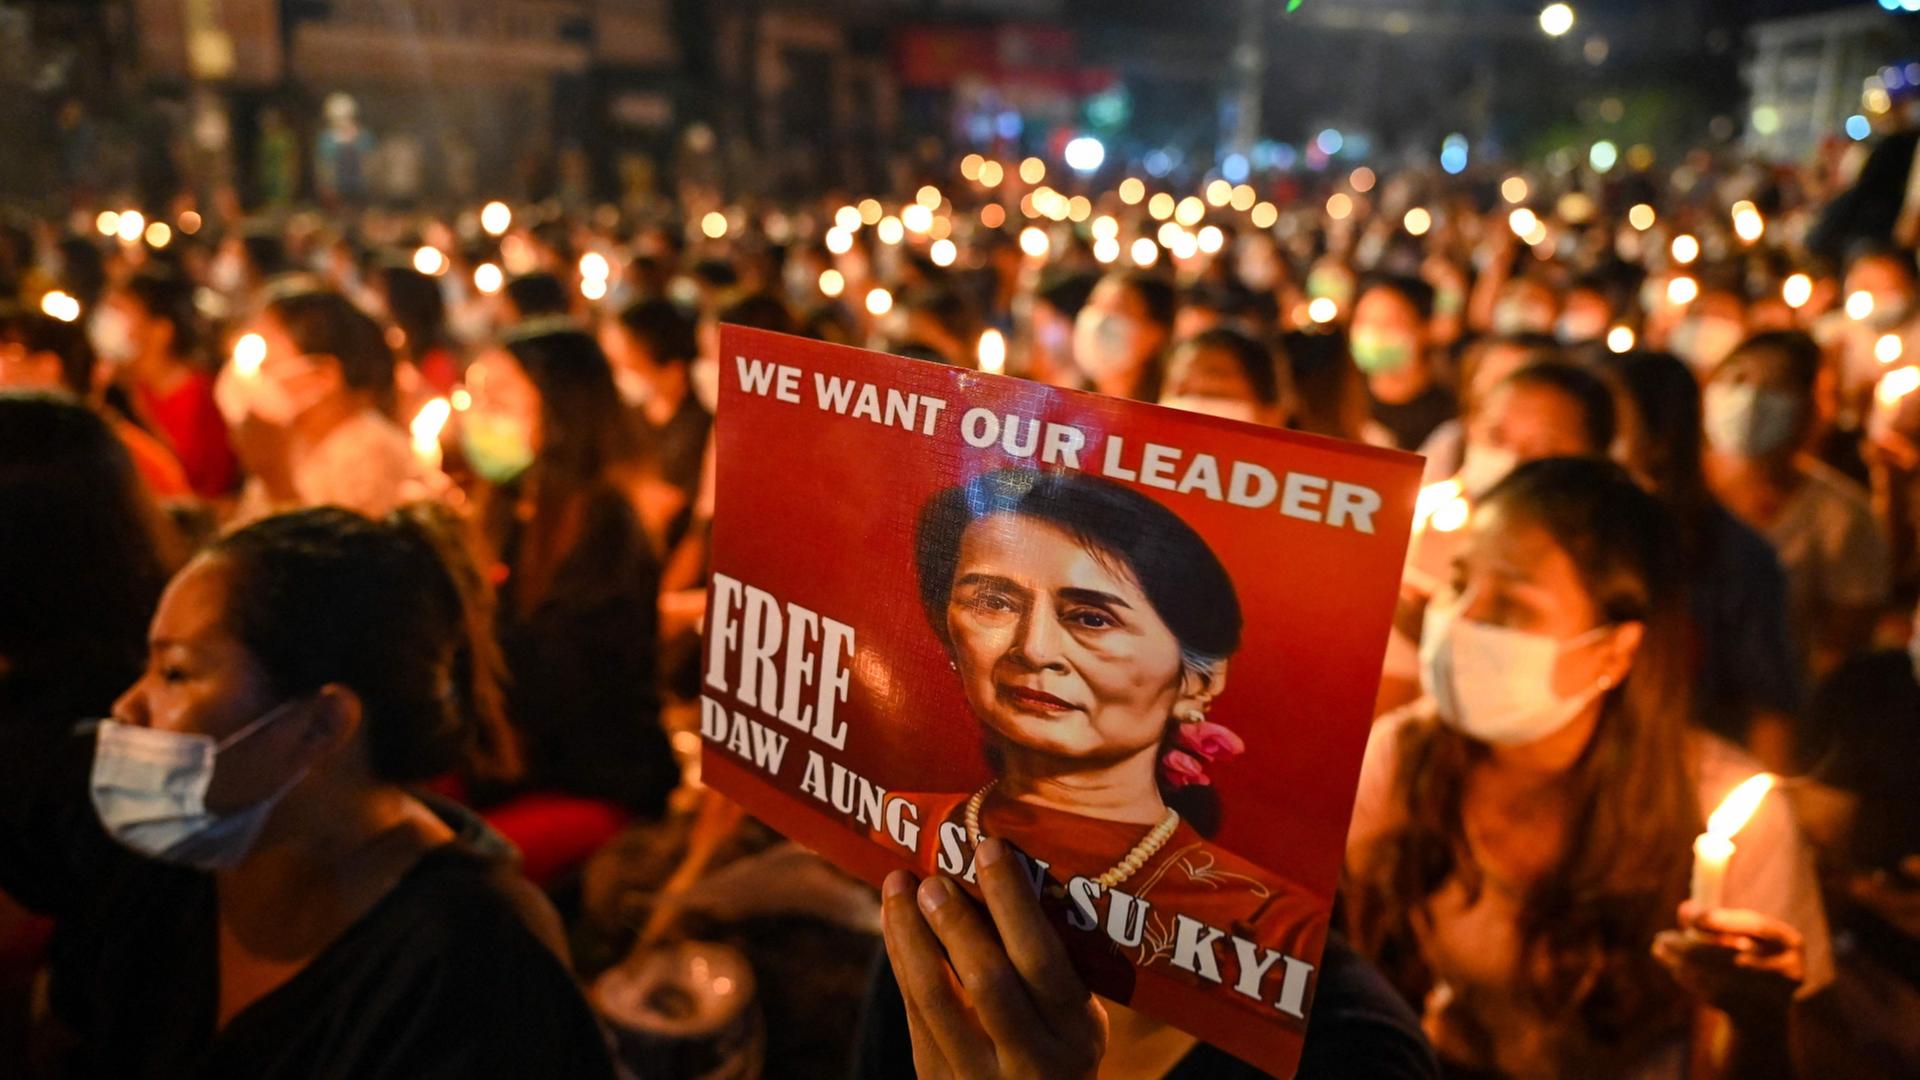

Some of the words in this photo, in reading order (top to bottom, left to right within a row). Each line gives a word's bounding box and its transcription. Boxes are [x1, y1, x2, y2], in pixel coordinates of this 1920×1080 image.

[736, 356, 802, 404] WE
[814, 372, 946, 436] WANT
[960, 407, 1086, 469] OUR
[1102, 435, 1382, 535] LEADER
[705, 572, 855, 751] FREE
[700, 694, 790, 776] DAW
[800, 750, 920, 853] AUNG
[1067, 876, 1150, 949] SU
[1170, 914, 1315, 1019] KYI
